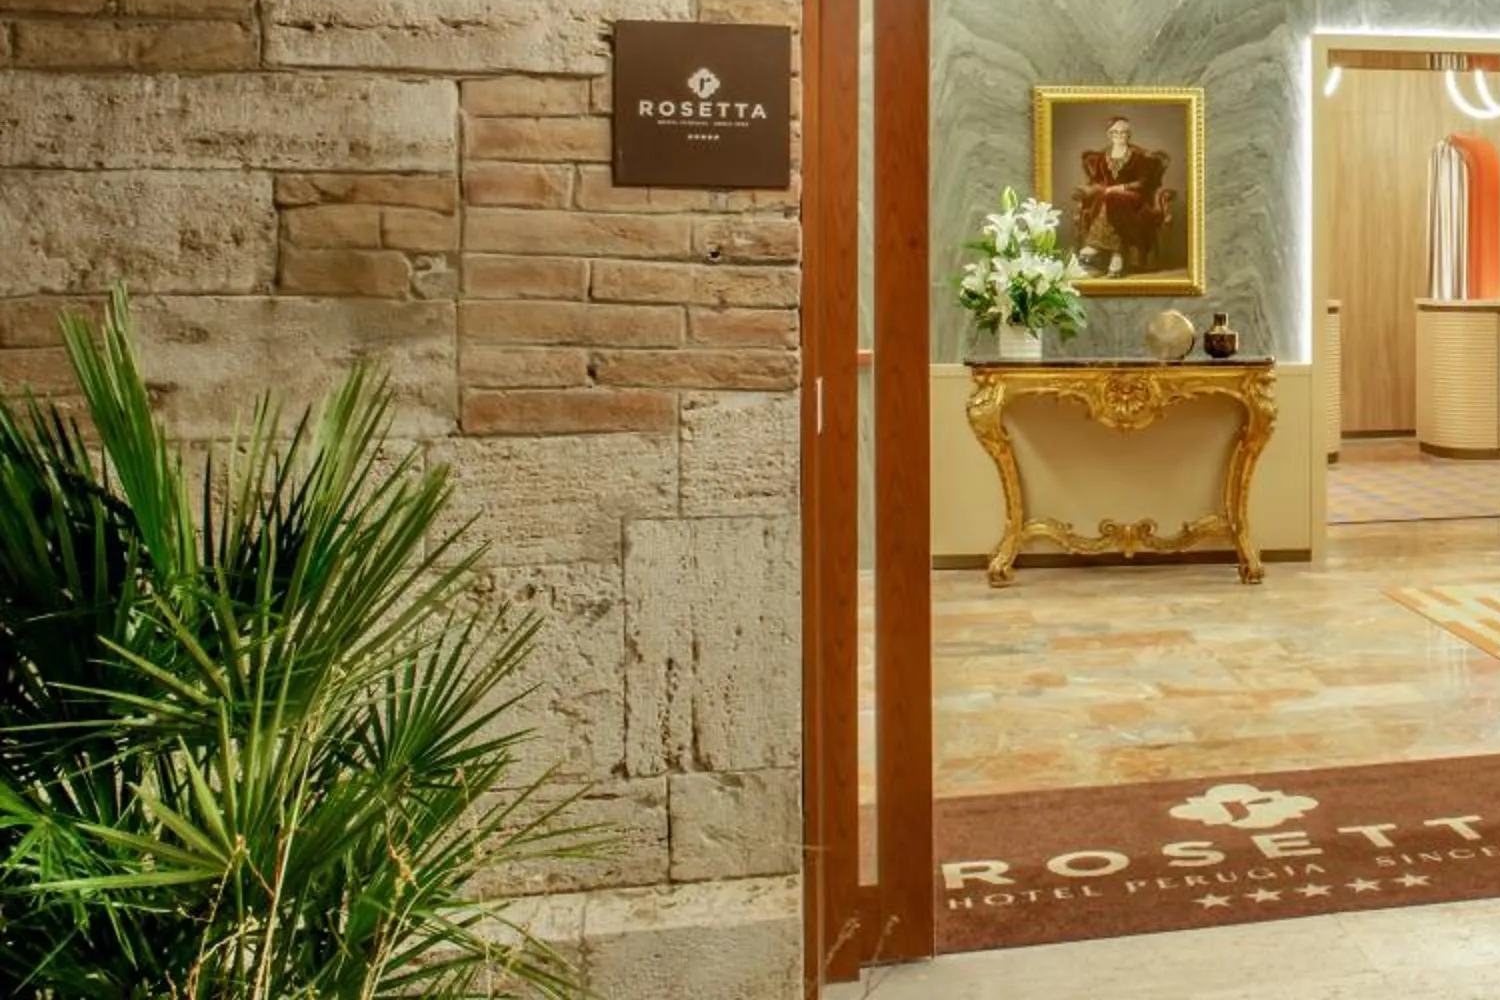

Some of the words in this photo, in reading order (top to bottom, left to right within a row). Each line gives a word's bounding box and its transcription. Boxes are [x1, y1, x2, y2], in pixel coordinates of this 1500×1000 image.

[638, 100, 767, 120] ROSETTA
[948, 886, 1104, 911] HOTEL
[1125, 862, 1327, 894] PERUGIA
